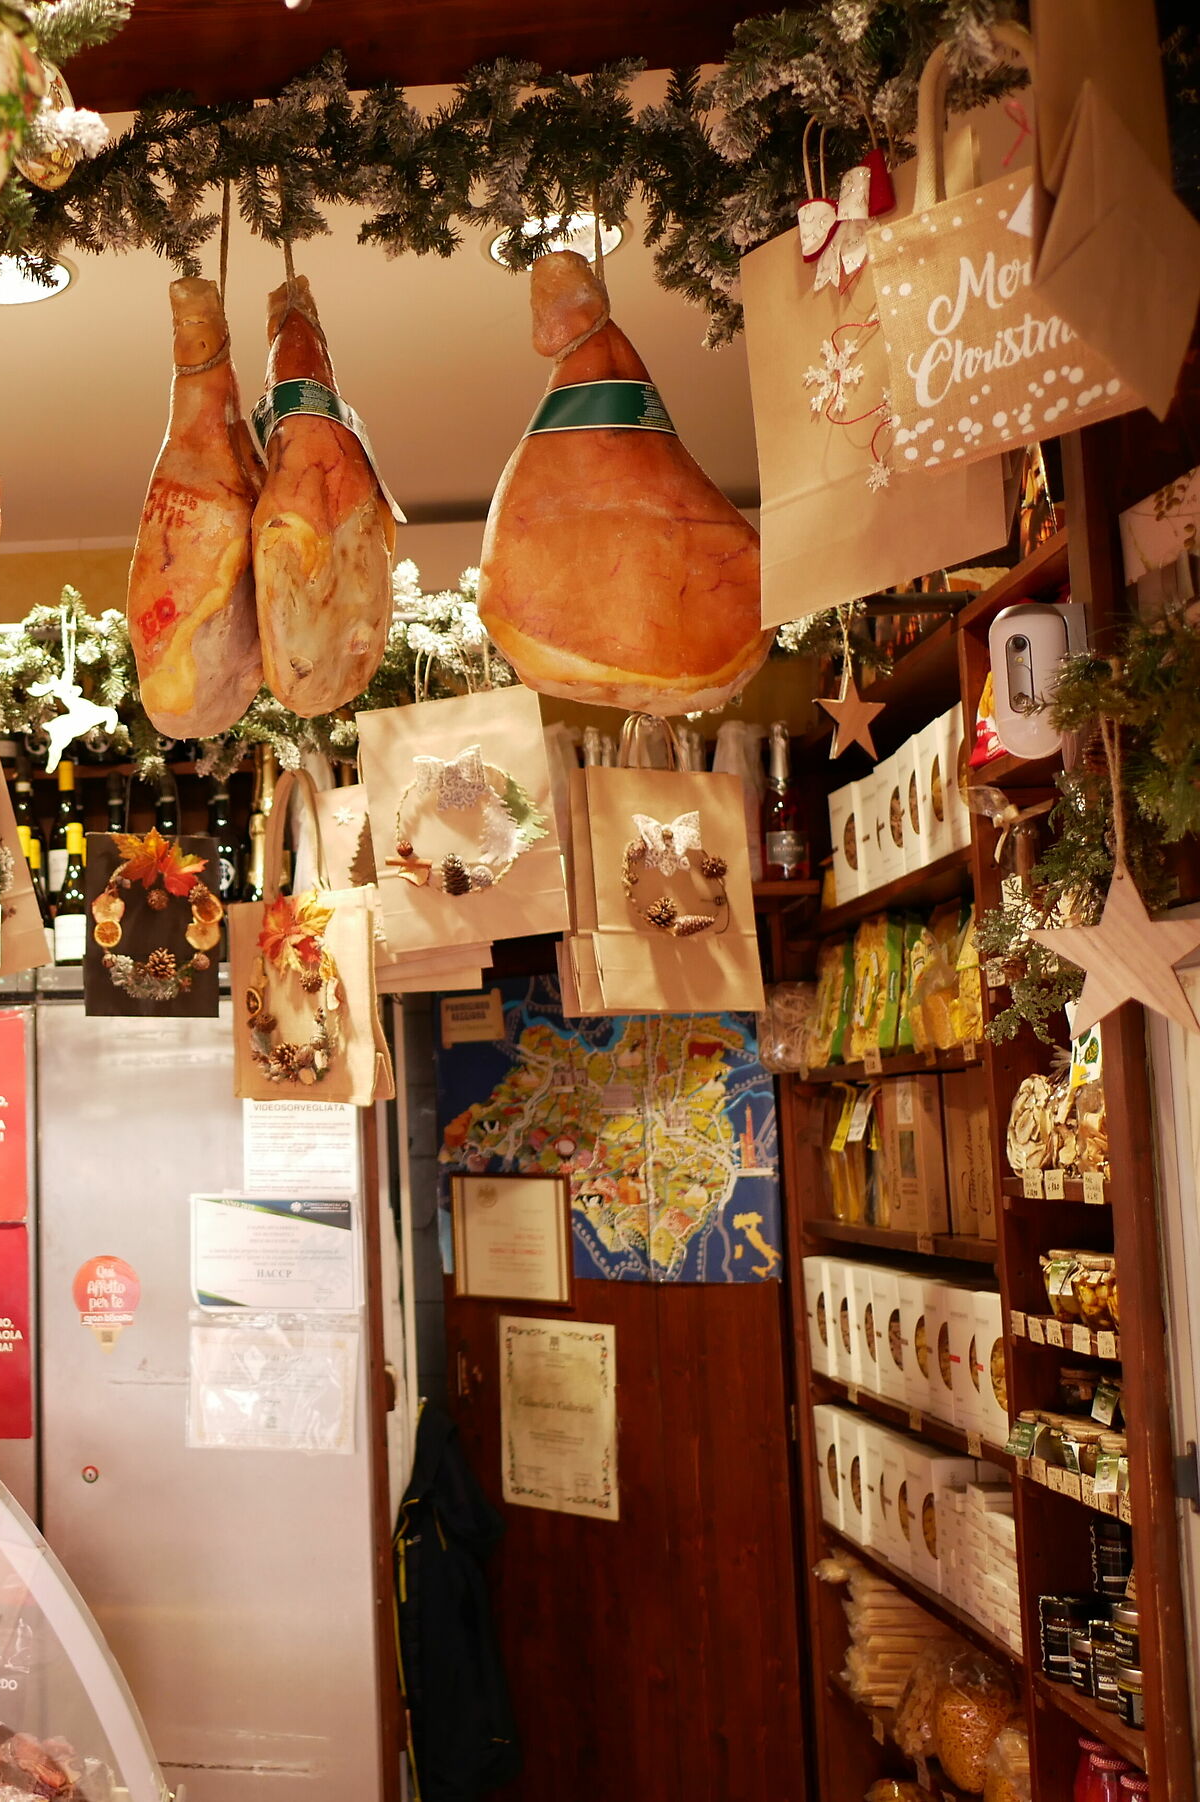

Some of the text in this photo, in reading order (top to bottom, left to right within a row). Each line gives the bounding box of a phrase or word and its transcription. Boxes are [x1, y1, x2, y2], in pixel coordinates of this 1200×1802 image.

[927, 250, 1033, 338] Mer
[906, 312, 1078, 408] Christm
[95, 1265, 116, 1279] Qui
[256, 1269, 292, 1279] HACCP
[86, 1279, 126, 1297] Affetto
[88, 1295, 125, 1311] per te
